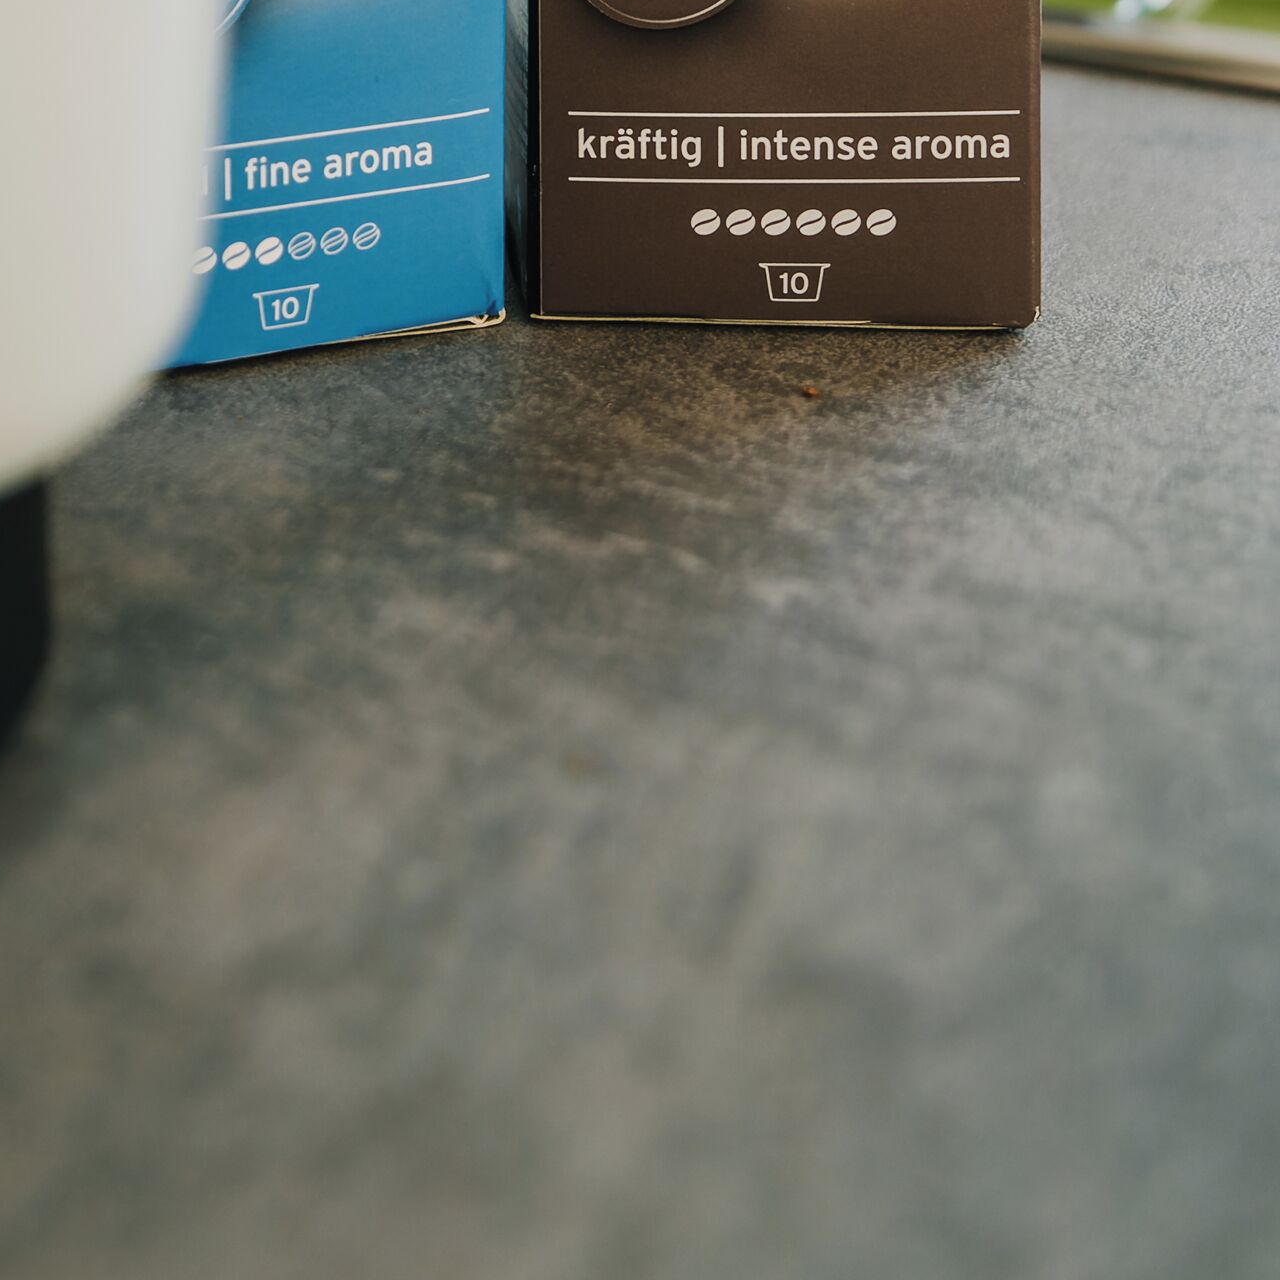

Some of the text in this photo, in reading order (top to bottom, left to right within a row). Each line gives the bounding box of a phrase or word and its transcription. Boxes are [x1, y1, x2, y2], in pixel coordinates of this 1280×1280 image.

[577, 127, 702, 169] kräftig
[739, 128, 878, 162] intense
[891, 134, 1010, 161] aroma
[244, 156, 312, 190] fine
[323, 141, 433, 179] aroma
[778, 271, 809, 296] 10
[271, 296, 300, 321] 10
